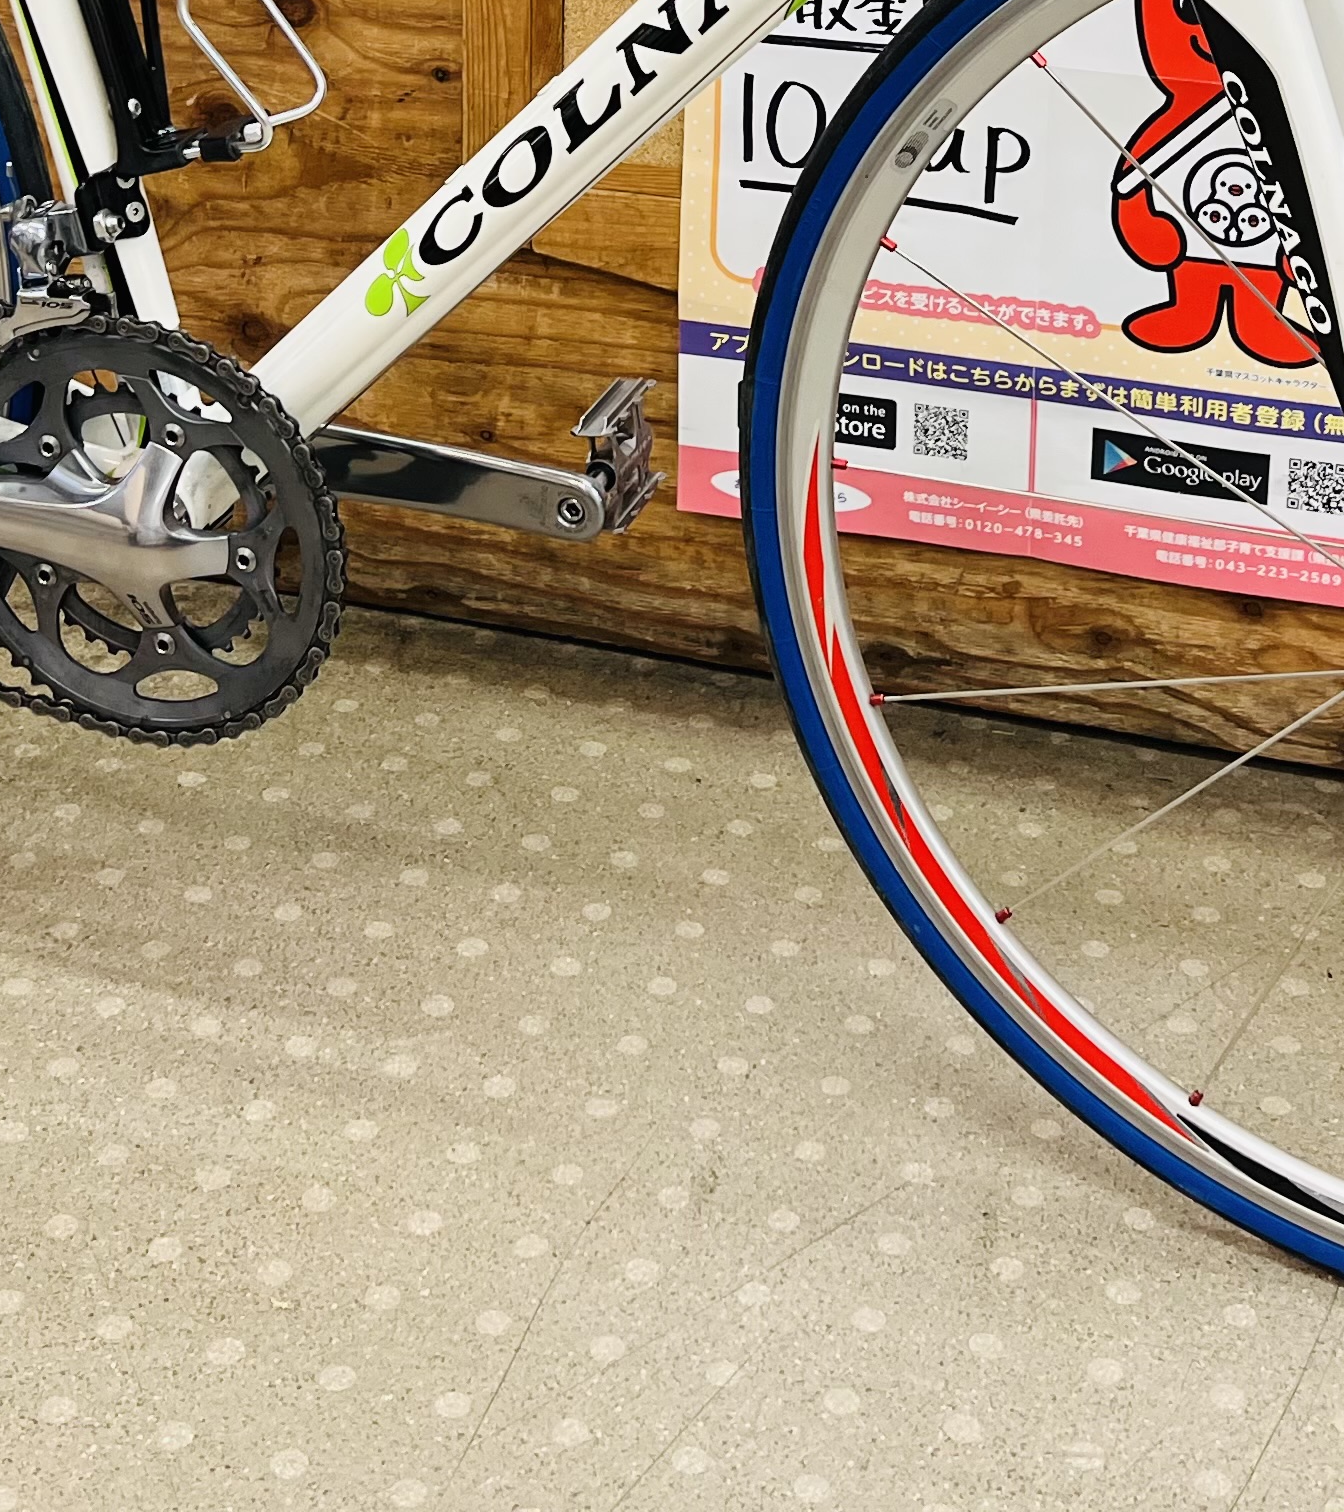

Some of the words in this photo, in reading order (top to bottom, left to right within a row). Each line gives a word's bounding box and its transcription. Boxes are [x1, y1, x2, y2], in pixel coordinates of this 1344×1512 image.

[1222, 71, 1332, 335] COLNAGO
[41, 301, 73, 310] 105
[1205, 367, 1328, 391] 千葉県マスコットキャラクター
[842, 403, 860, 414] on
[863, 403, 886, 418] the
[1143, 455, 1213, 486] Google
[1222, 469, 1263, 492] play
[903, 490, 1021, 516] 株式会社シーイーシー
